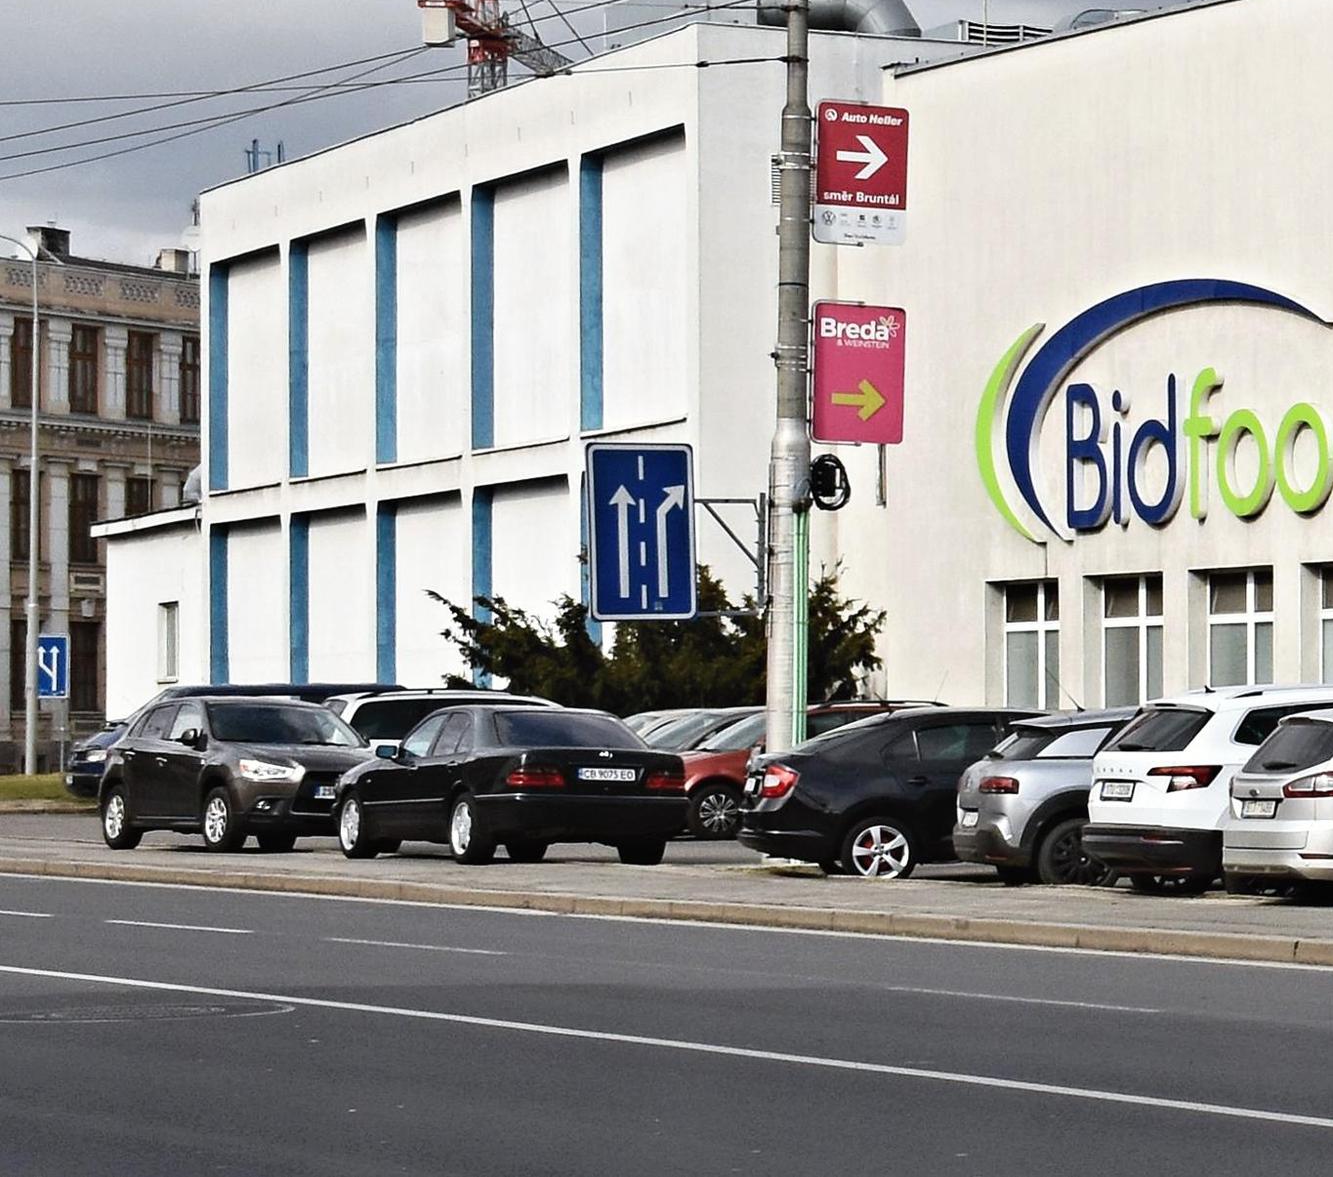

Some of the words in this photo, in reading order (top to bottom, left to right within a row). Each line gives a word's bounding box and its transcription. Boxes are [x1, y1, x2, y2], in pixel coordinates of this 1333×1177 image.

[841, 112, 867, 124] Auto
[869, 114, 903, 126] Heller
[823, 191, 852, 202] směr
[856, 191, 899, 205] Bruntál
[820, 317, 890, 341] Breda
